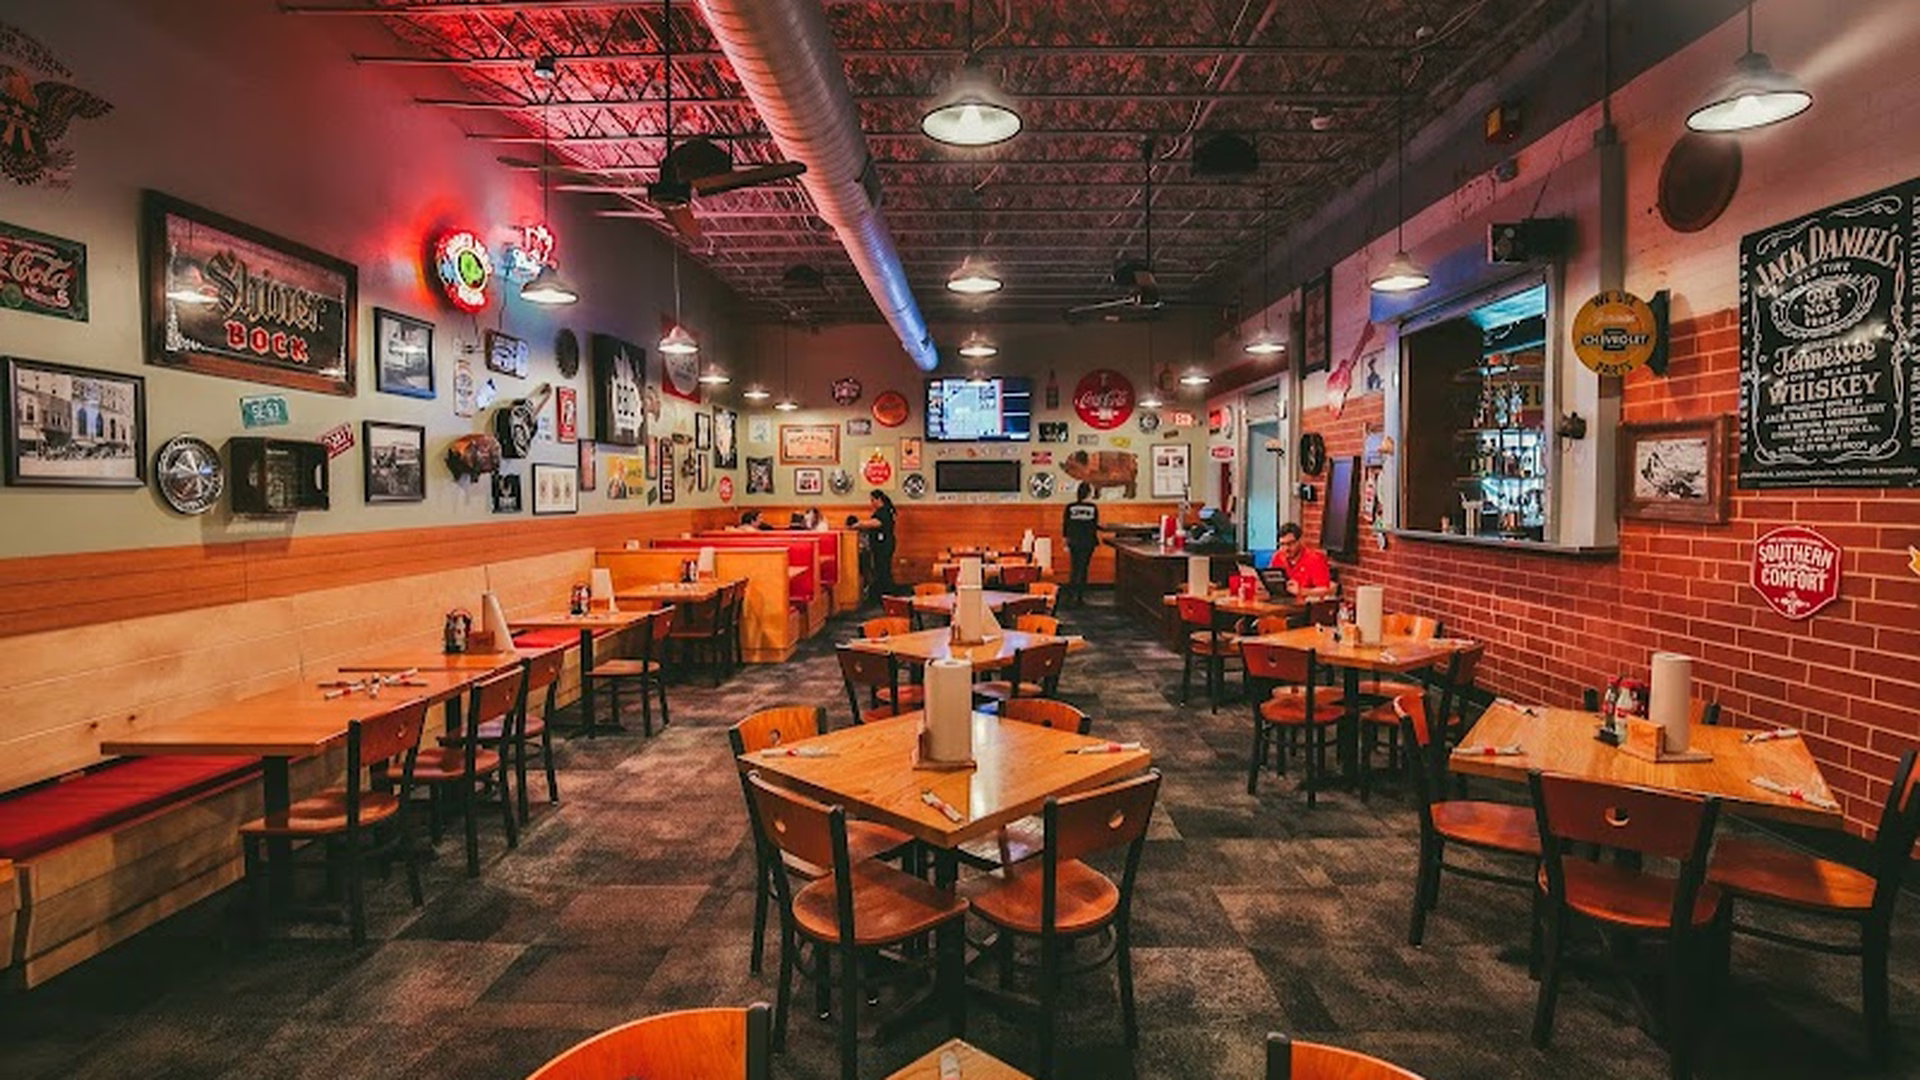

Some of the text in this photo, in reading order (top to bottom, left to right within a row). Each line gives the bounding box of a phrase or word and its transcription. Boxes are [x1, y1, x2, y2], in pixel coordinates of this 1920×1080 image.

[1755, 223, 1903, 298] JACK DANIEL'S
[1822, 262, 1851, 274] TIME
[204, 249, 322, 333] Shiner
[224, 320, 310, 363] BOCK
[1773, 341, 1877, 376] Tennessee
[1769, 372, 1882, 405] WHISKEY
[1759, 544, 1834, 570] SOUTHERN
[1761, 567, 1829, 593] COMFORT
